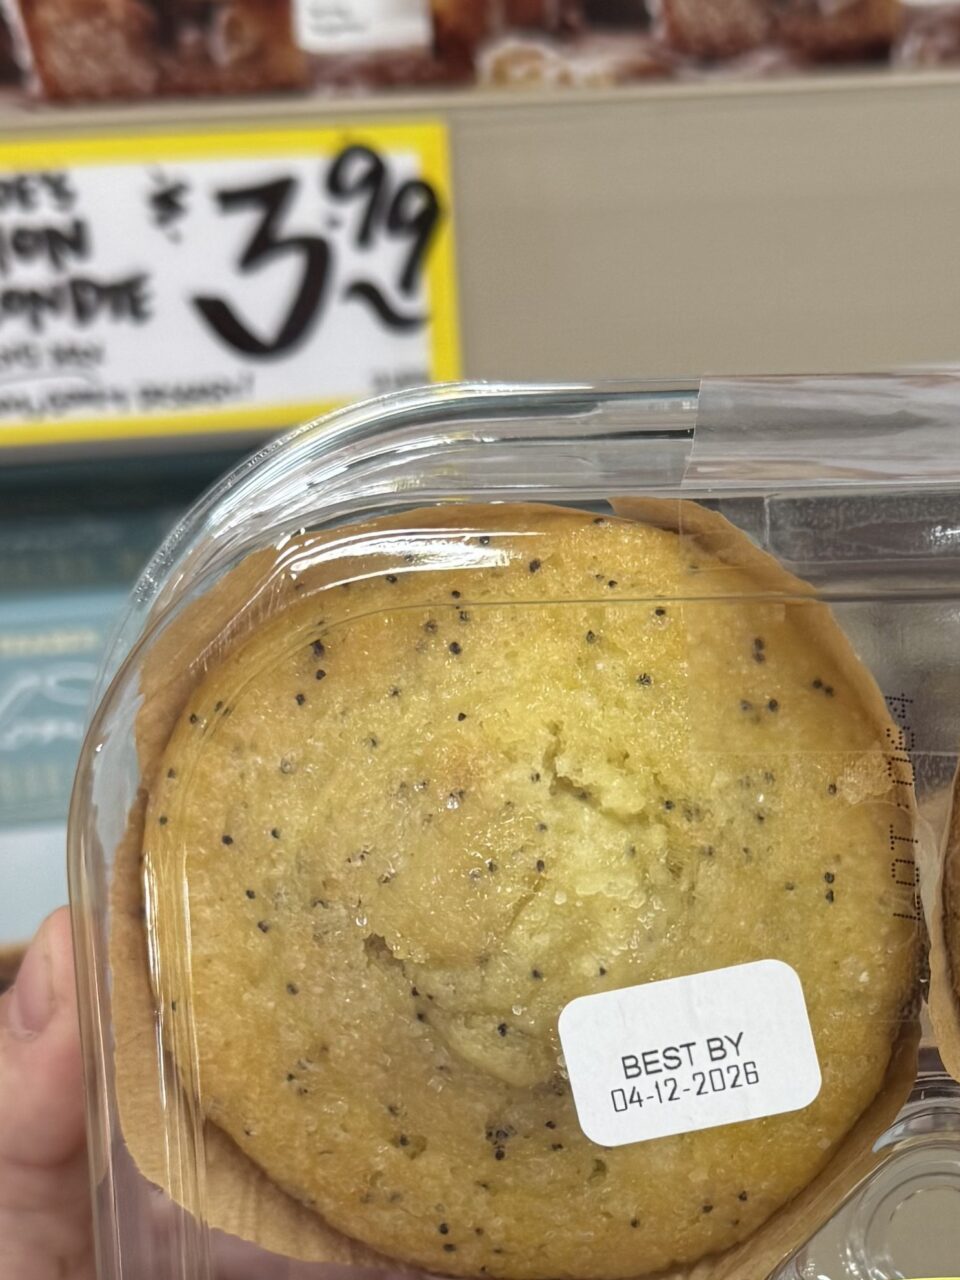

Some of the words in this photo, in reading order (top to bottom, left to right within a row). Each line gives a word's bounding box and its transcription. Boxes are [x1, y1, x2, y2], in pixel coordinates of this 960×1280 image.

[621, 1041, 697, 1081] BEST
[705, 1031, 745, 1063] BY
[610, 1060, 760, 1114] 04-12-2026
